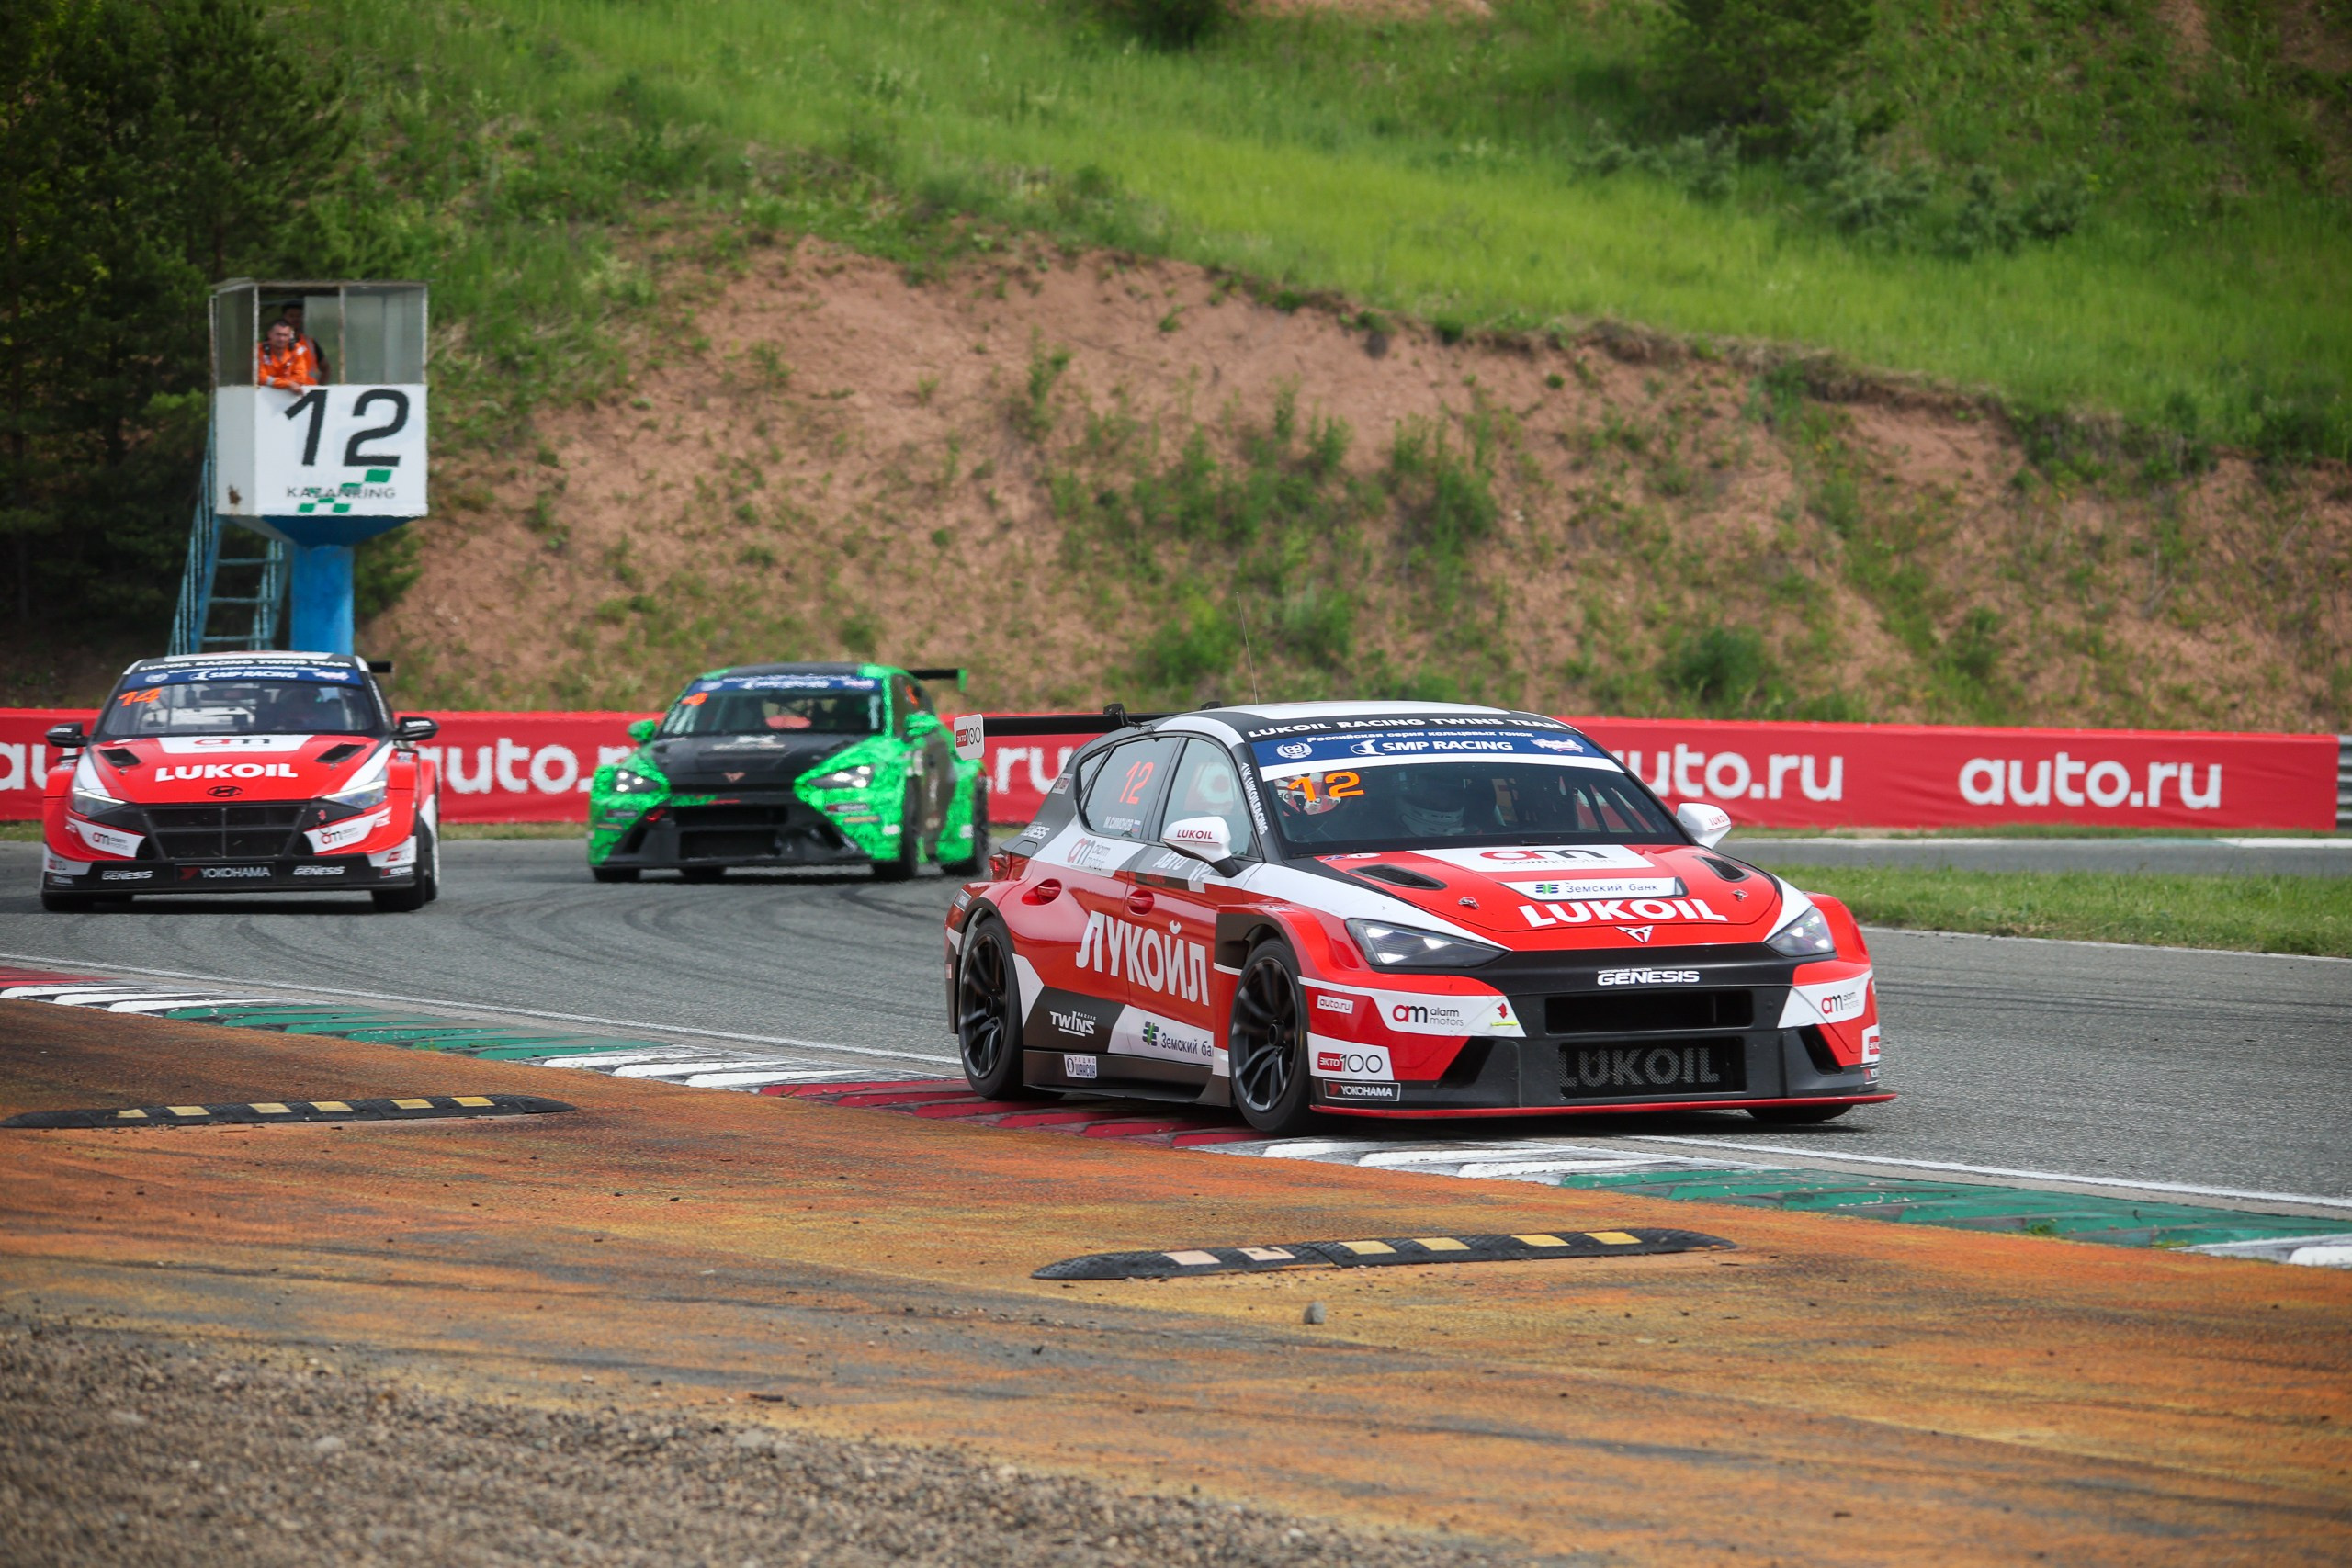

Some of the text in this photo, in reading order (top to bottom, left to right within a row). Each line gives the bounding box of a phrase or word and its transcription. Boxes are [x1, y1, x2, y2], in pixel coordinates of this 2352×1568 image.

[284, 389, 410, 467] 12
[118, 688, 163, 706] 14
[1248, 722, 1332, 738] LUKOIL
[1337, 719, 1425, 728] RACING
[1506, 719, 1567, 730] TEAM
[1306, 732, 1384, 742] Российская
[1382, 740, 1514, 752] SMP RACING
[154, 763, 299, 782] LUKOIL
[1958, 751, 2222, 809] auto.ru
[1119, 761, 1155, 805] 12
[1287, 771, 1365, 802] 12
[1176, 829, 1213, 840] LUKOIL
[101, 870, 153, 880] GENESIS
[200, 867, 271, 878] YOKOHAMA
[292, 865, 346, 875] GENESIS
[1566, 883, 1658, 893] Земский банк
[1518, 898, 1729, 928] LUKOIL
[1076, 909, 1210, 1007] ЛУКОЙЛ
[1597, 970, 1700, 986] GENESIS
[1319, 998, 1351, 1012] auto.ru
[1392, 1004, 1428, 1024] am
[1430, 1009, 1460, 1018] alarm
[1049, 1010, 1095, 1035] TWINS
[1430, 1016, 1464, 1027] motors
[1160, 1032, 1214, 1057] Земский ба
[1559, 1047, 1721, 1088] LUKOIL
[1340, 1084, 1393, 1098] YOKOHAMA
